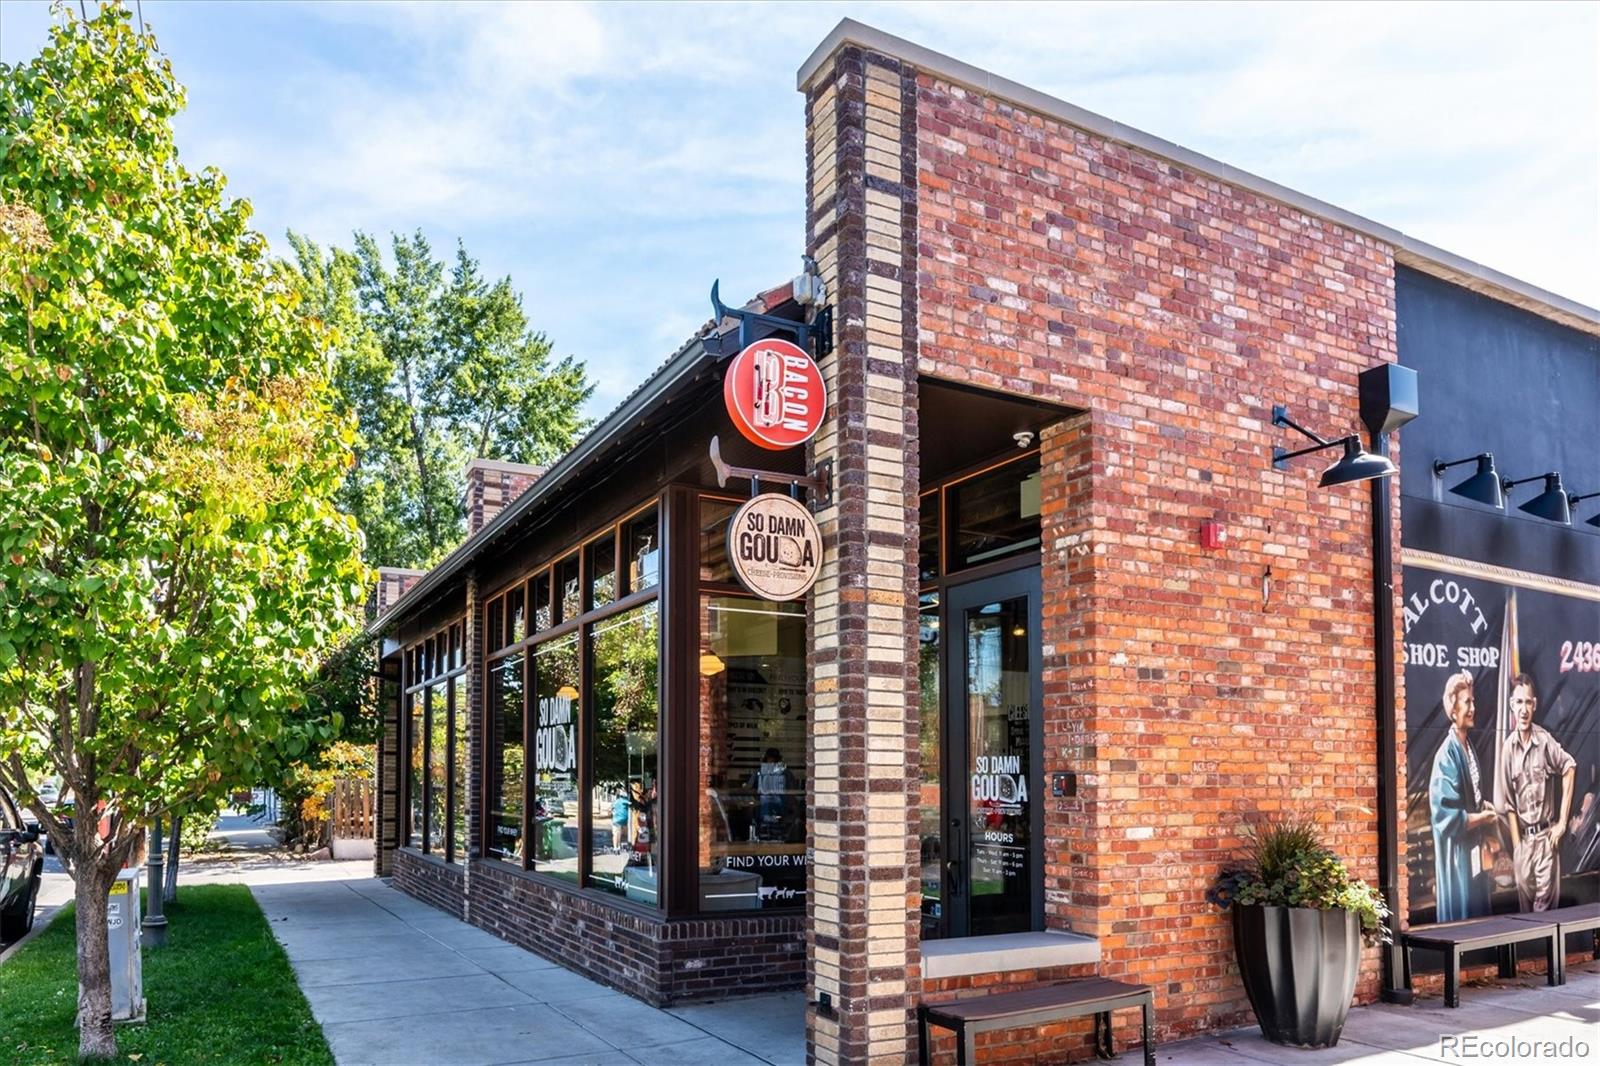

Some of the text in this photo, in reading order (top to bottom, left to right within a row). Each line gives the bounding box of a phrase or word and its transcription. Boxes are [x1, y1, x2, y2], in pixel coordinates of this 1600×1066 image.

[783, 355, 809, 432] BACON
[747, 512, 806, 538] SO DAMN
[740, 532, 814, 568] GOUDA
[1402, 579, 1488, 635] ALCOTT
[1457, 646, 1500, 668] SHOP
[539, 695, 571, 727] SO DAMN
[536, 724, 576, 772] GOUDA
[976, 755, 1020, 774] SO DAMN
[971, 774, 1028, 803] GOUDA
[984, 831, 1014, 843] HOURS
[726, 856, 755, 868] FIND
[757, 855, 790, 867] YOUR
